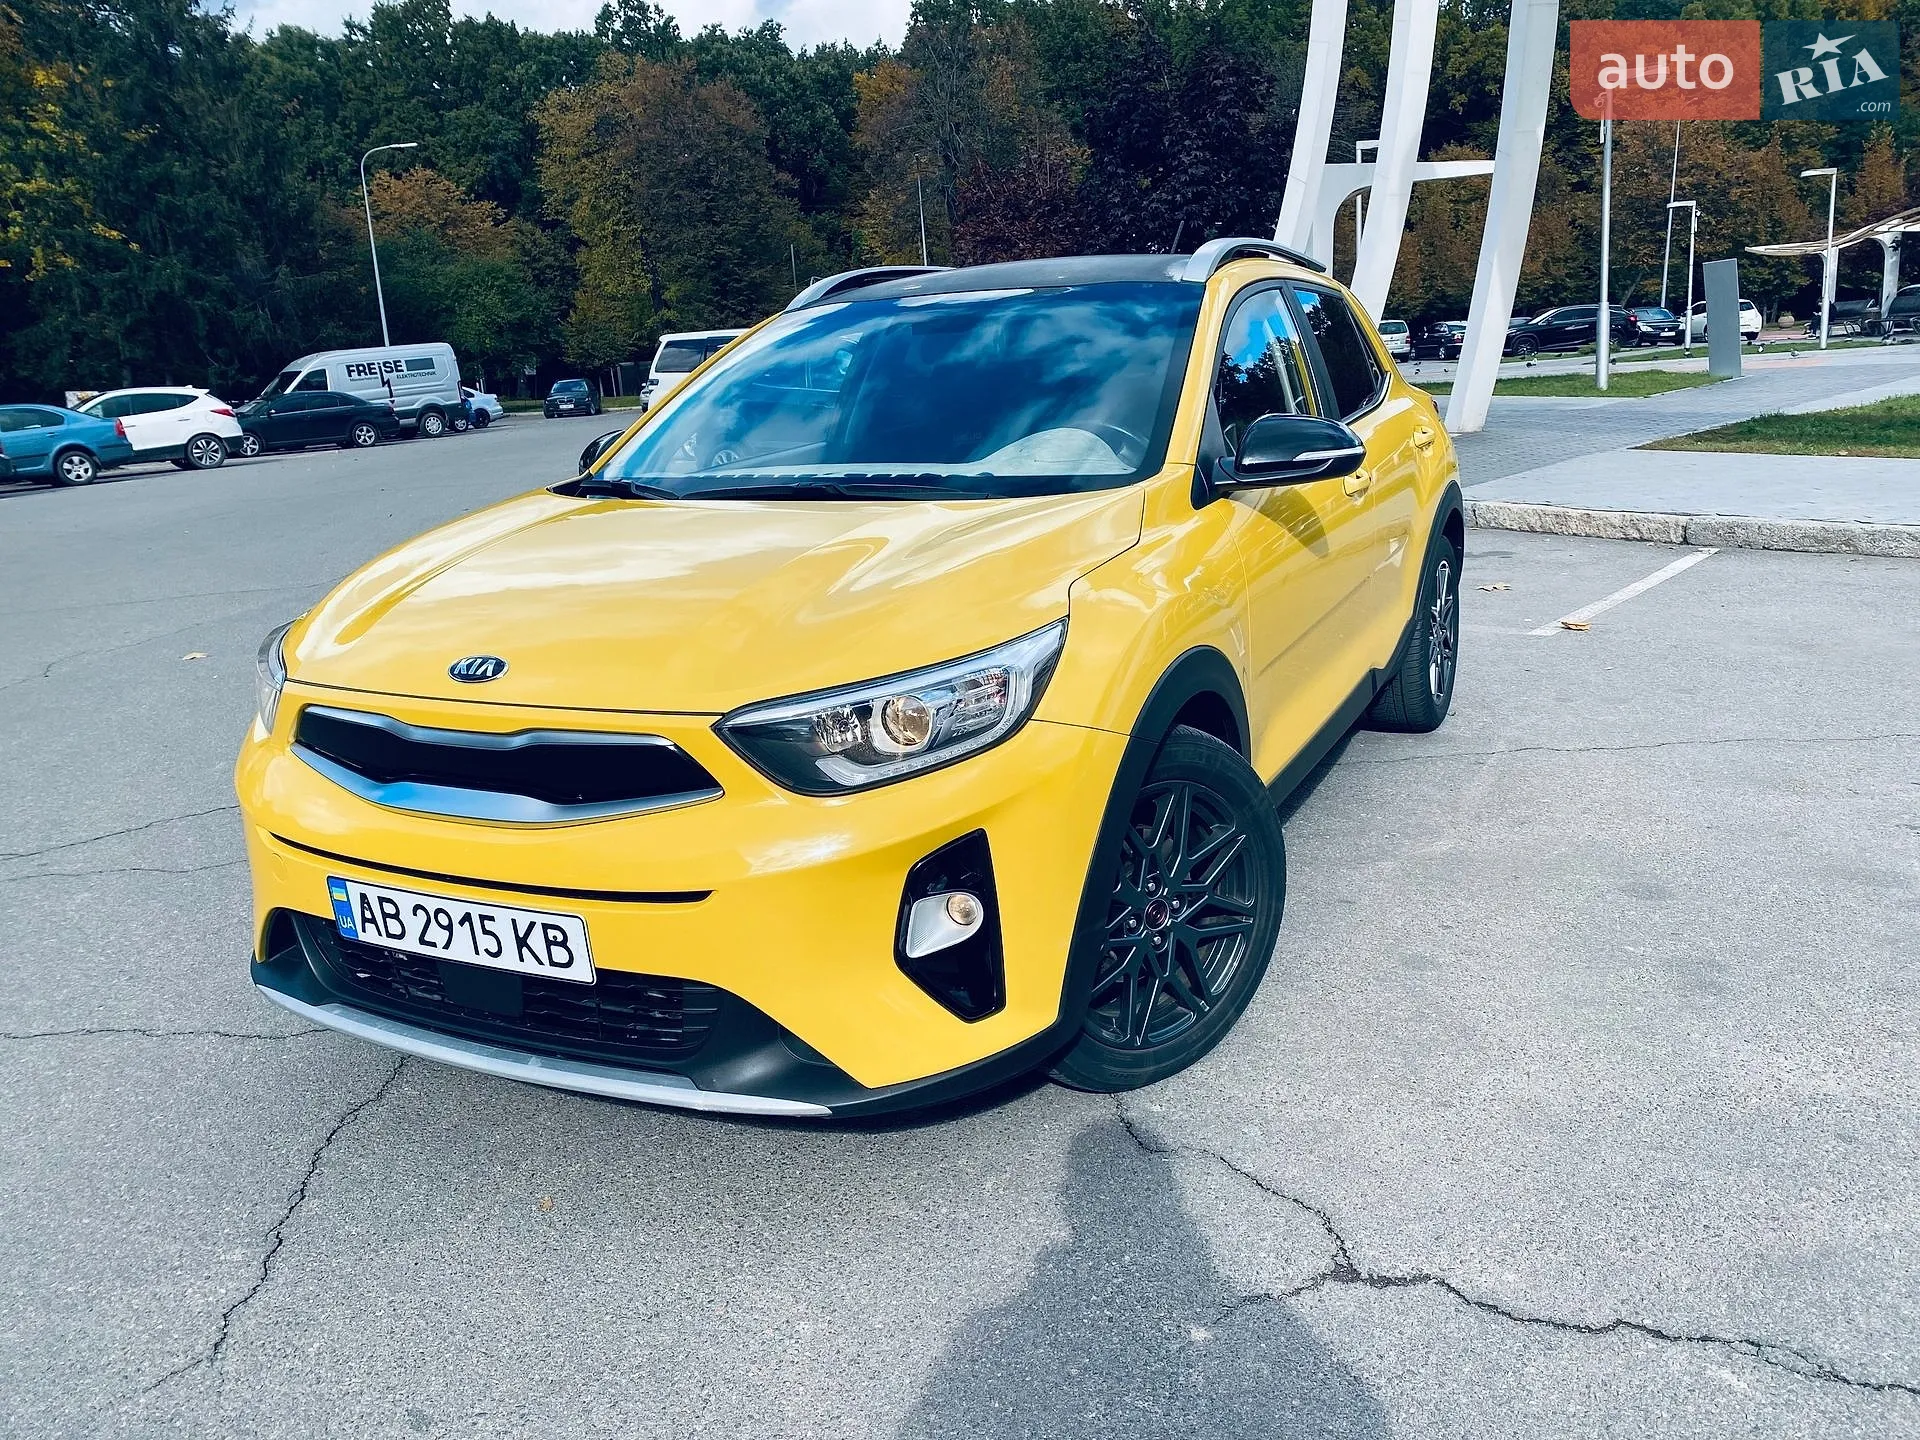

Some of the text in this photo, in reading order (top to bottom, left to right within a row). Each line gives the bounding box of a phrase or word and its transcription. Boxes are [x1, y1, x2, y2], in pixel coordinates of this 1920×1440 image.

[453, 658, 496, 677] KIA
[339, 916, 356, 931] UA
[359, 892, 575, 969] AB 2915 KB
